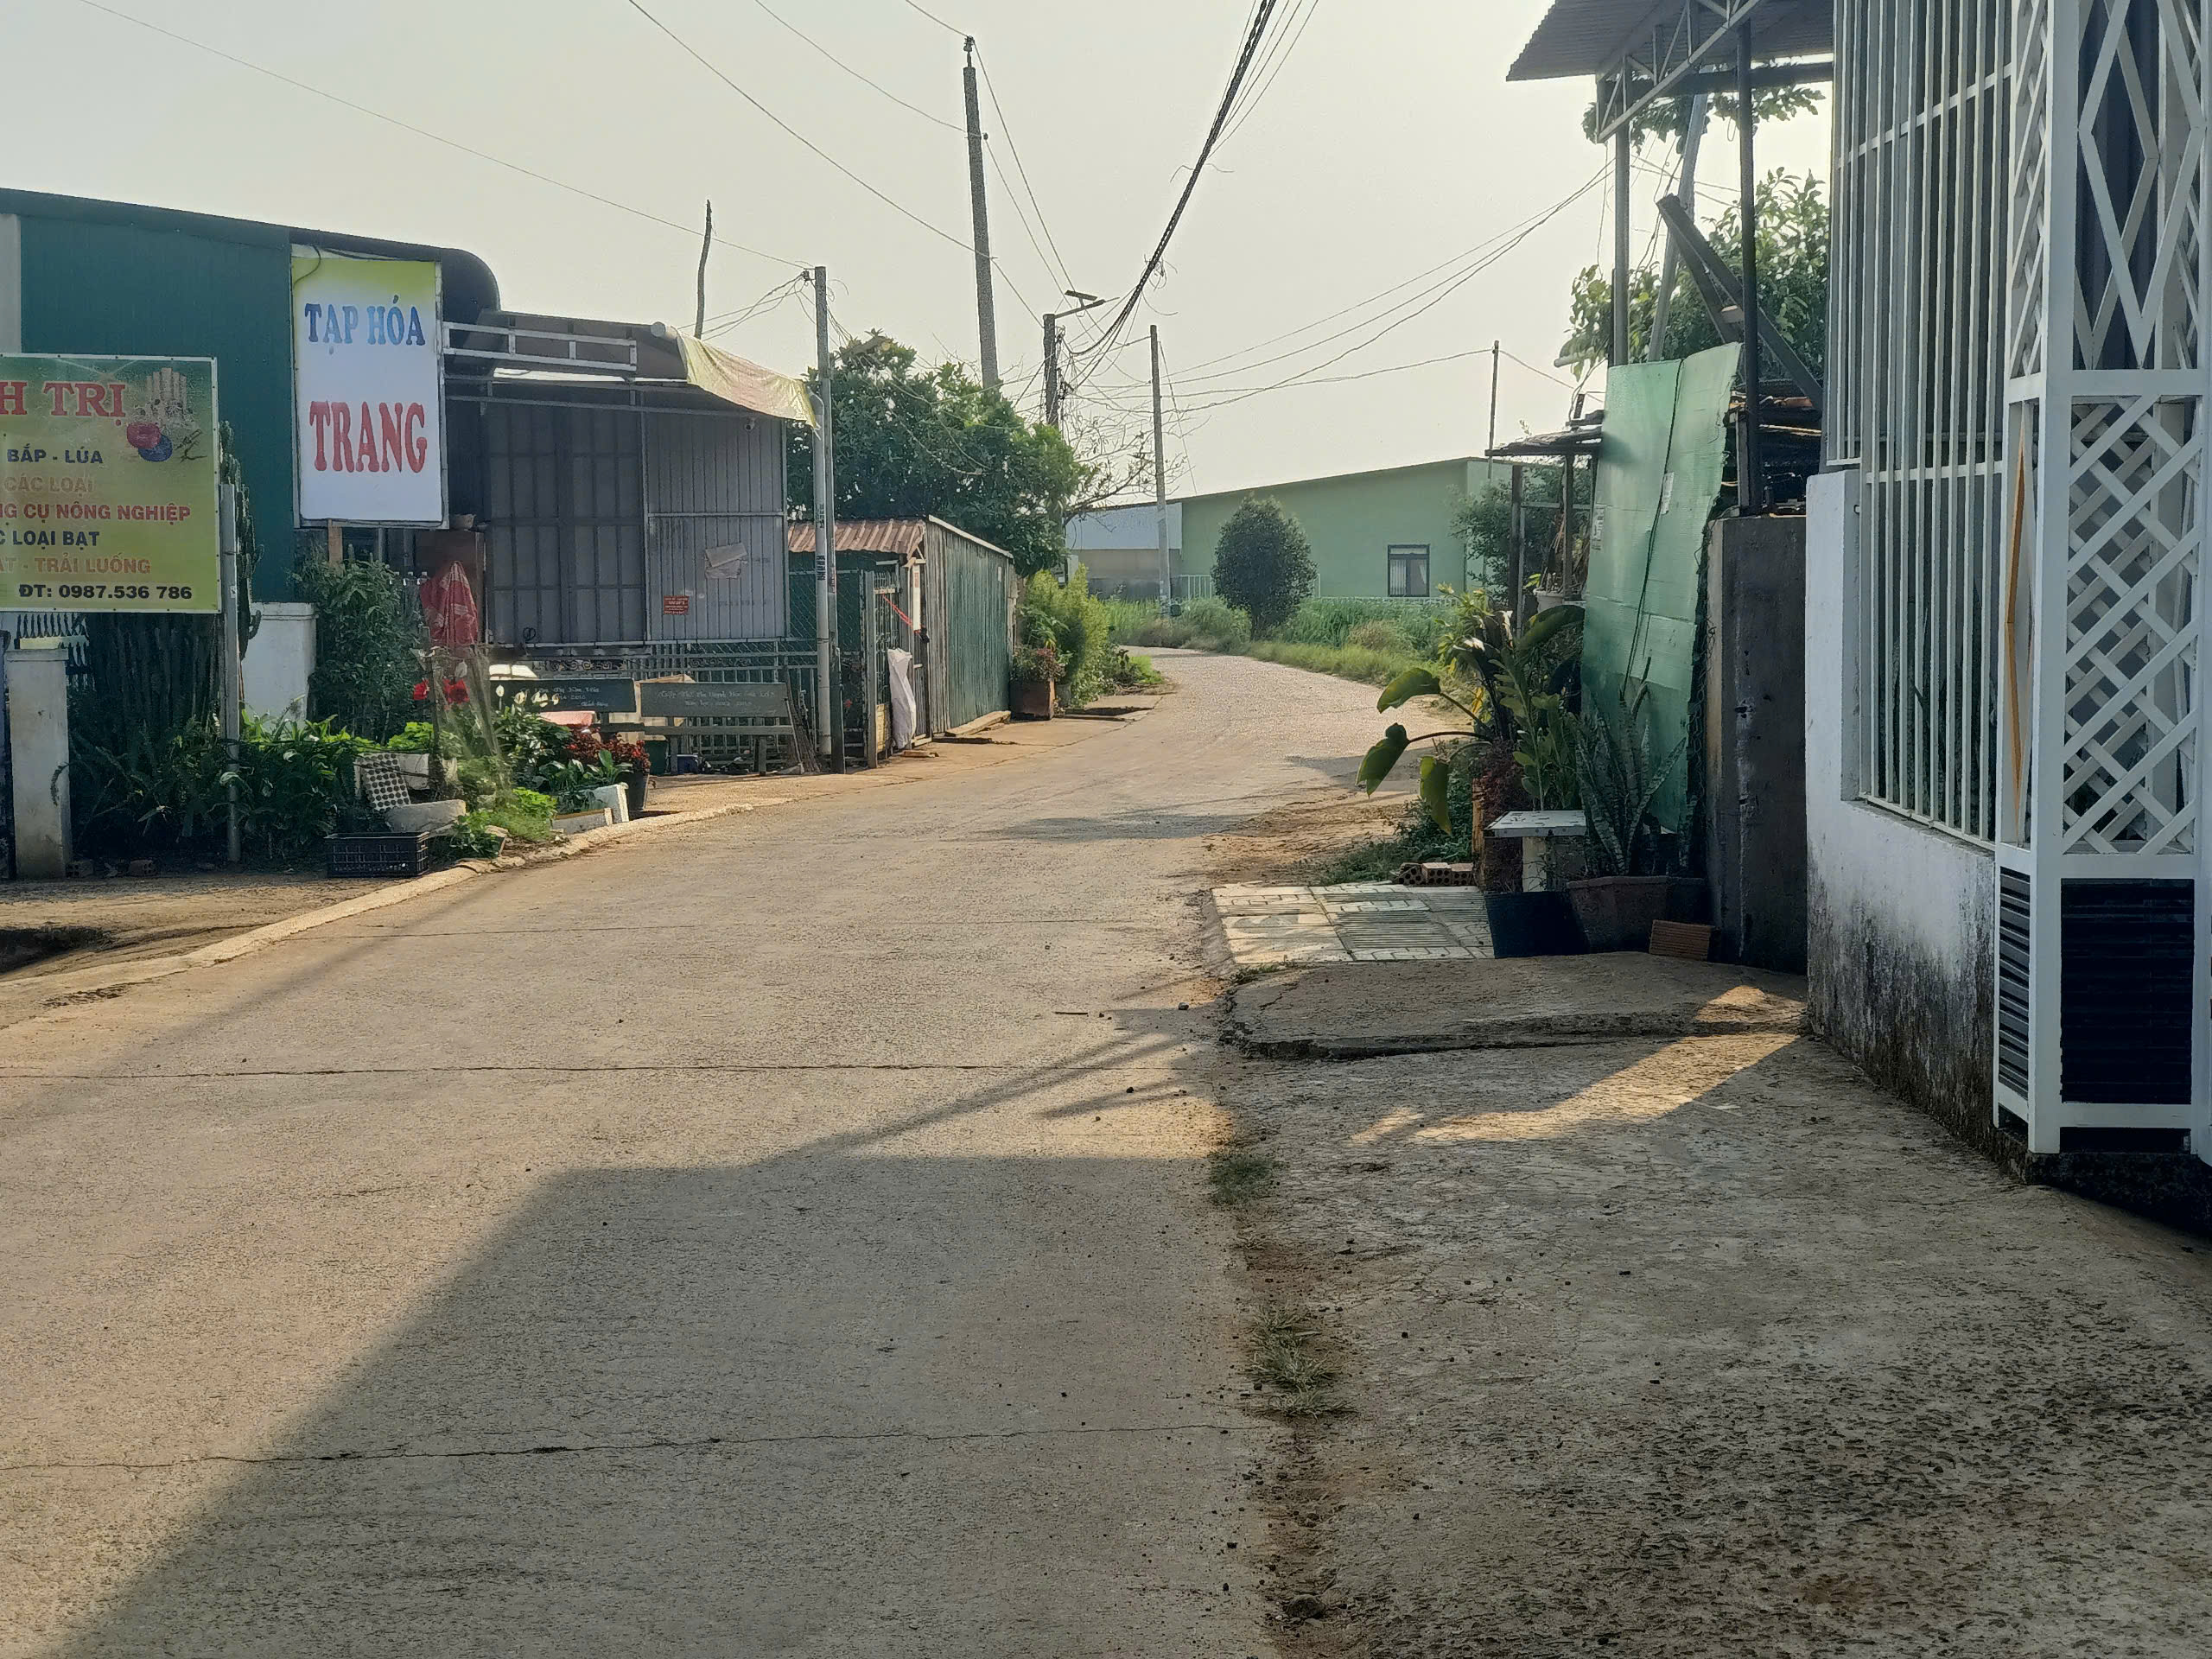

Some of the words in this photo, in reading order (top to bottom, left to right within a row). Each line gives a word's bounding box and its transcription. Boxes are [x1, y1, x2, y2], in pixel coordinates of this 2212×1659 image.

[304, 302, 358, 355] TẠP
[366, 294, 426, 346] HÓA
[43, 383, 126, 426] TRỊ
[309, 400, 428, 473] TRANG
[7, 443, 47, 462] BẮP
[23, 503, 49, 524] CỤ
[56, 501, 111, 519] NÔNG
[118, 503, 191, 525] NGHIỆP
[12, 530, 56, 550] LOẠI
[63, 531, 100, 550] BẠT
[19, 583, 52, 598] ĐT:
[59, 584, 149, 599] 0987.536
[156, 586, 192, 600] 786
